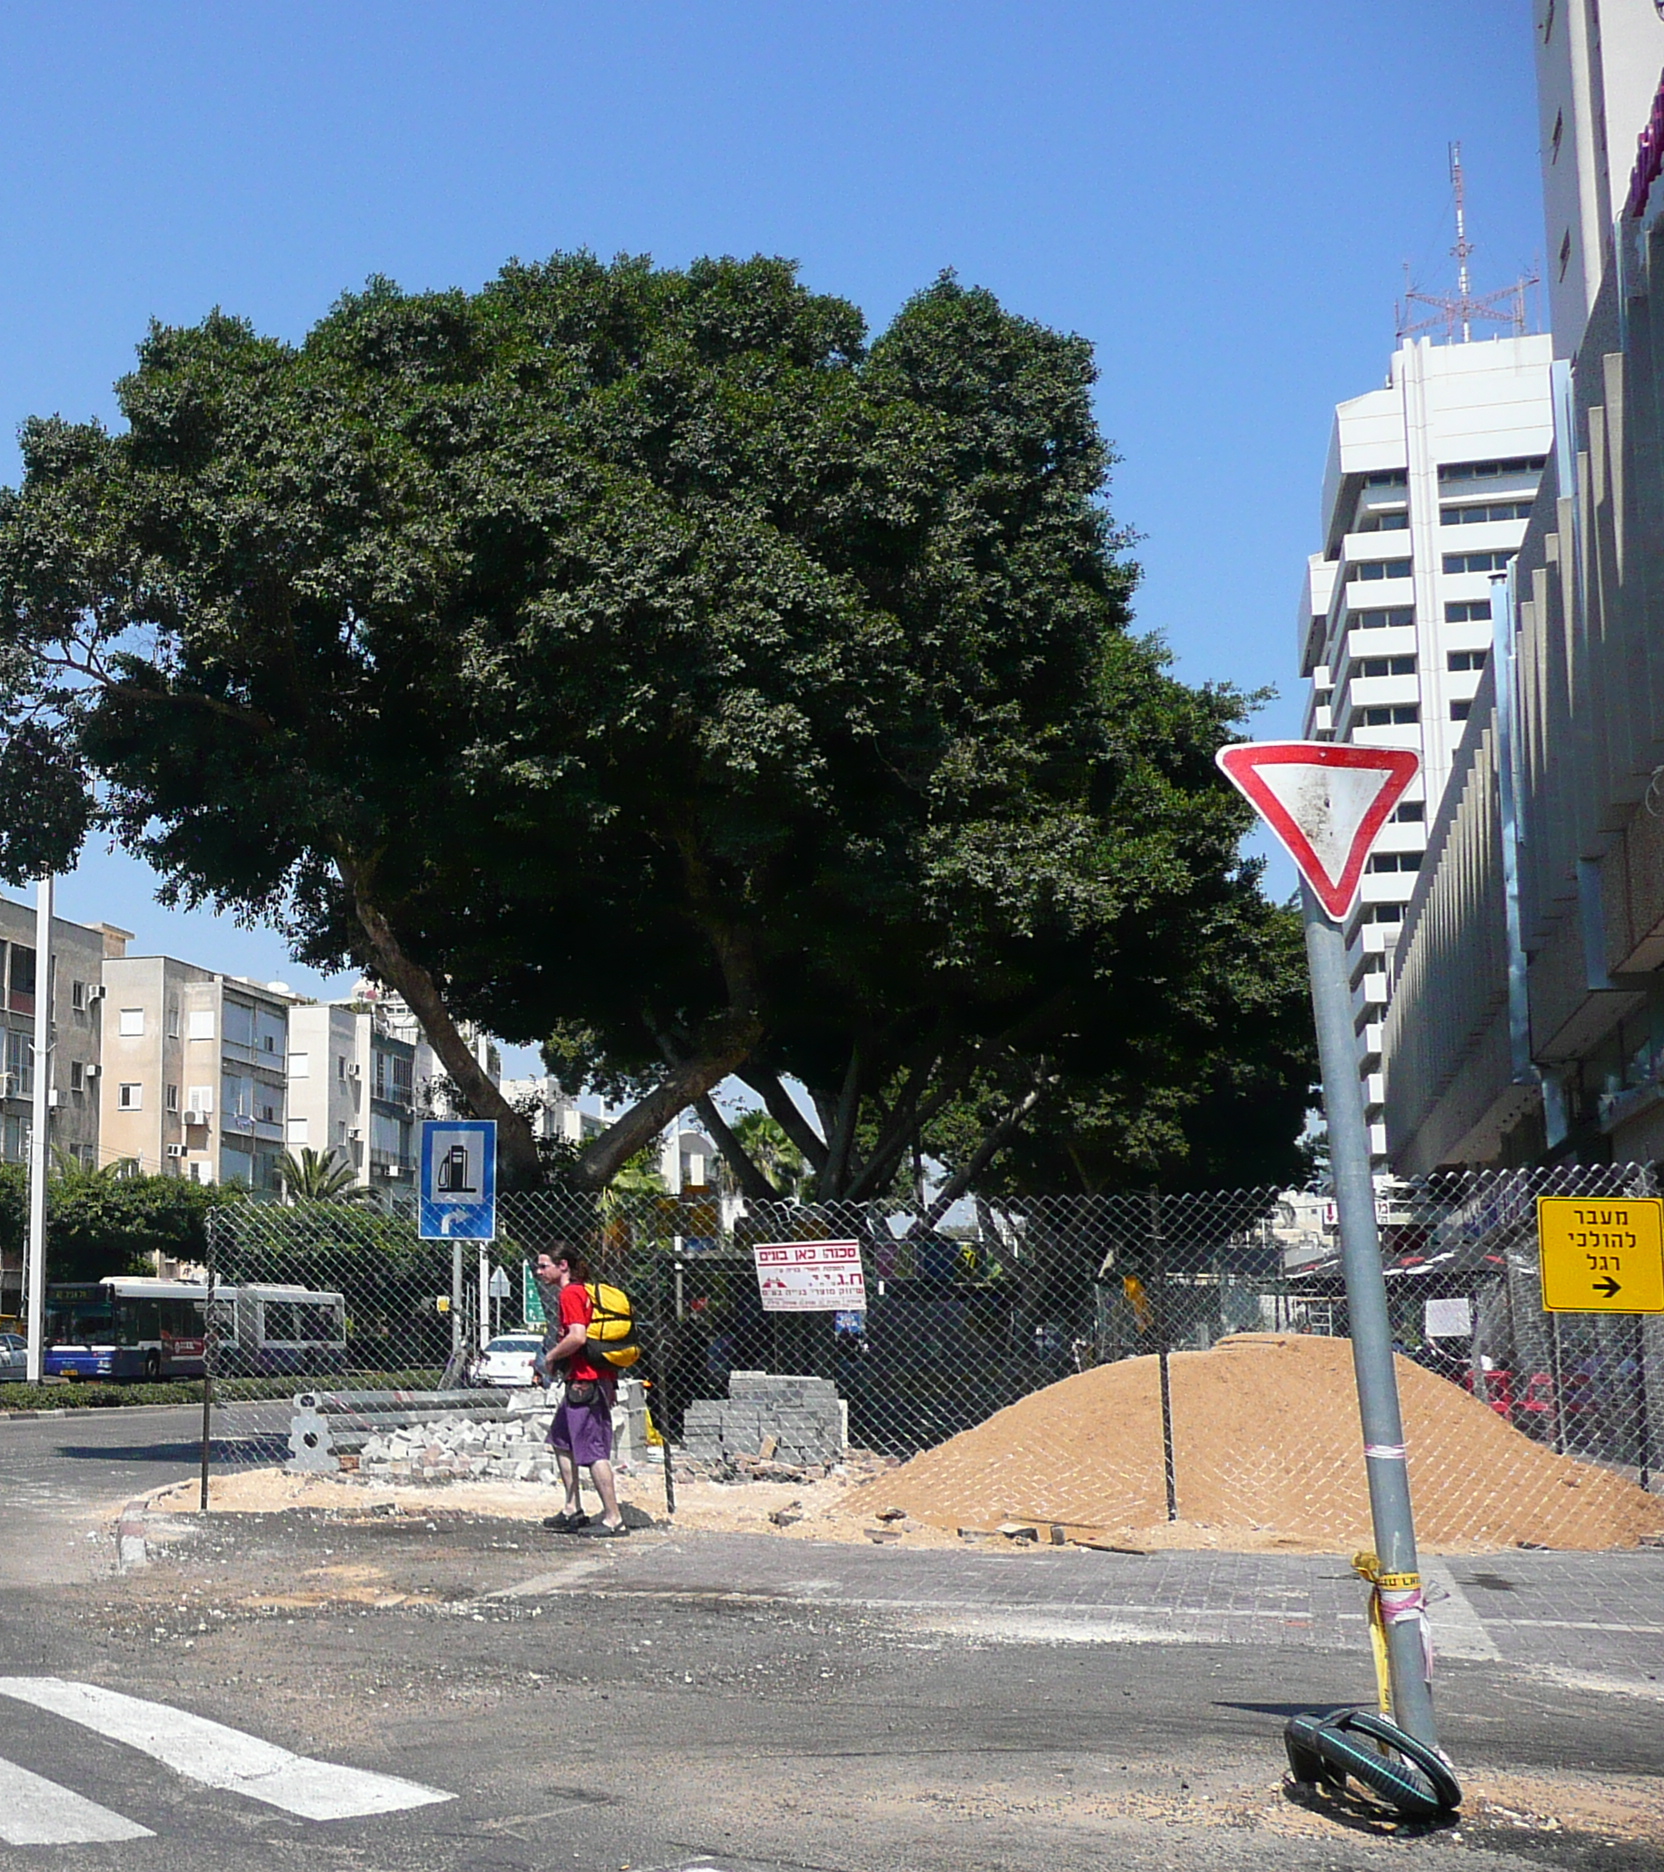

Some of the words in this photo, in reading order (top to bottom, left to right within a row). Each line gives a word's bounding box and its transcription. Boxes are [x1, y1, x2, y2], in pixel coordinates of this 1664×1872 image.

[1574, 1210, 1628, 1225] מעבר
[1567, 1230, 1636, 1248] להולכי
[795, 1249, 816, 1261] כאן
[1586, 1253, 1621, 1271] רגל
